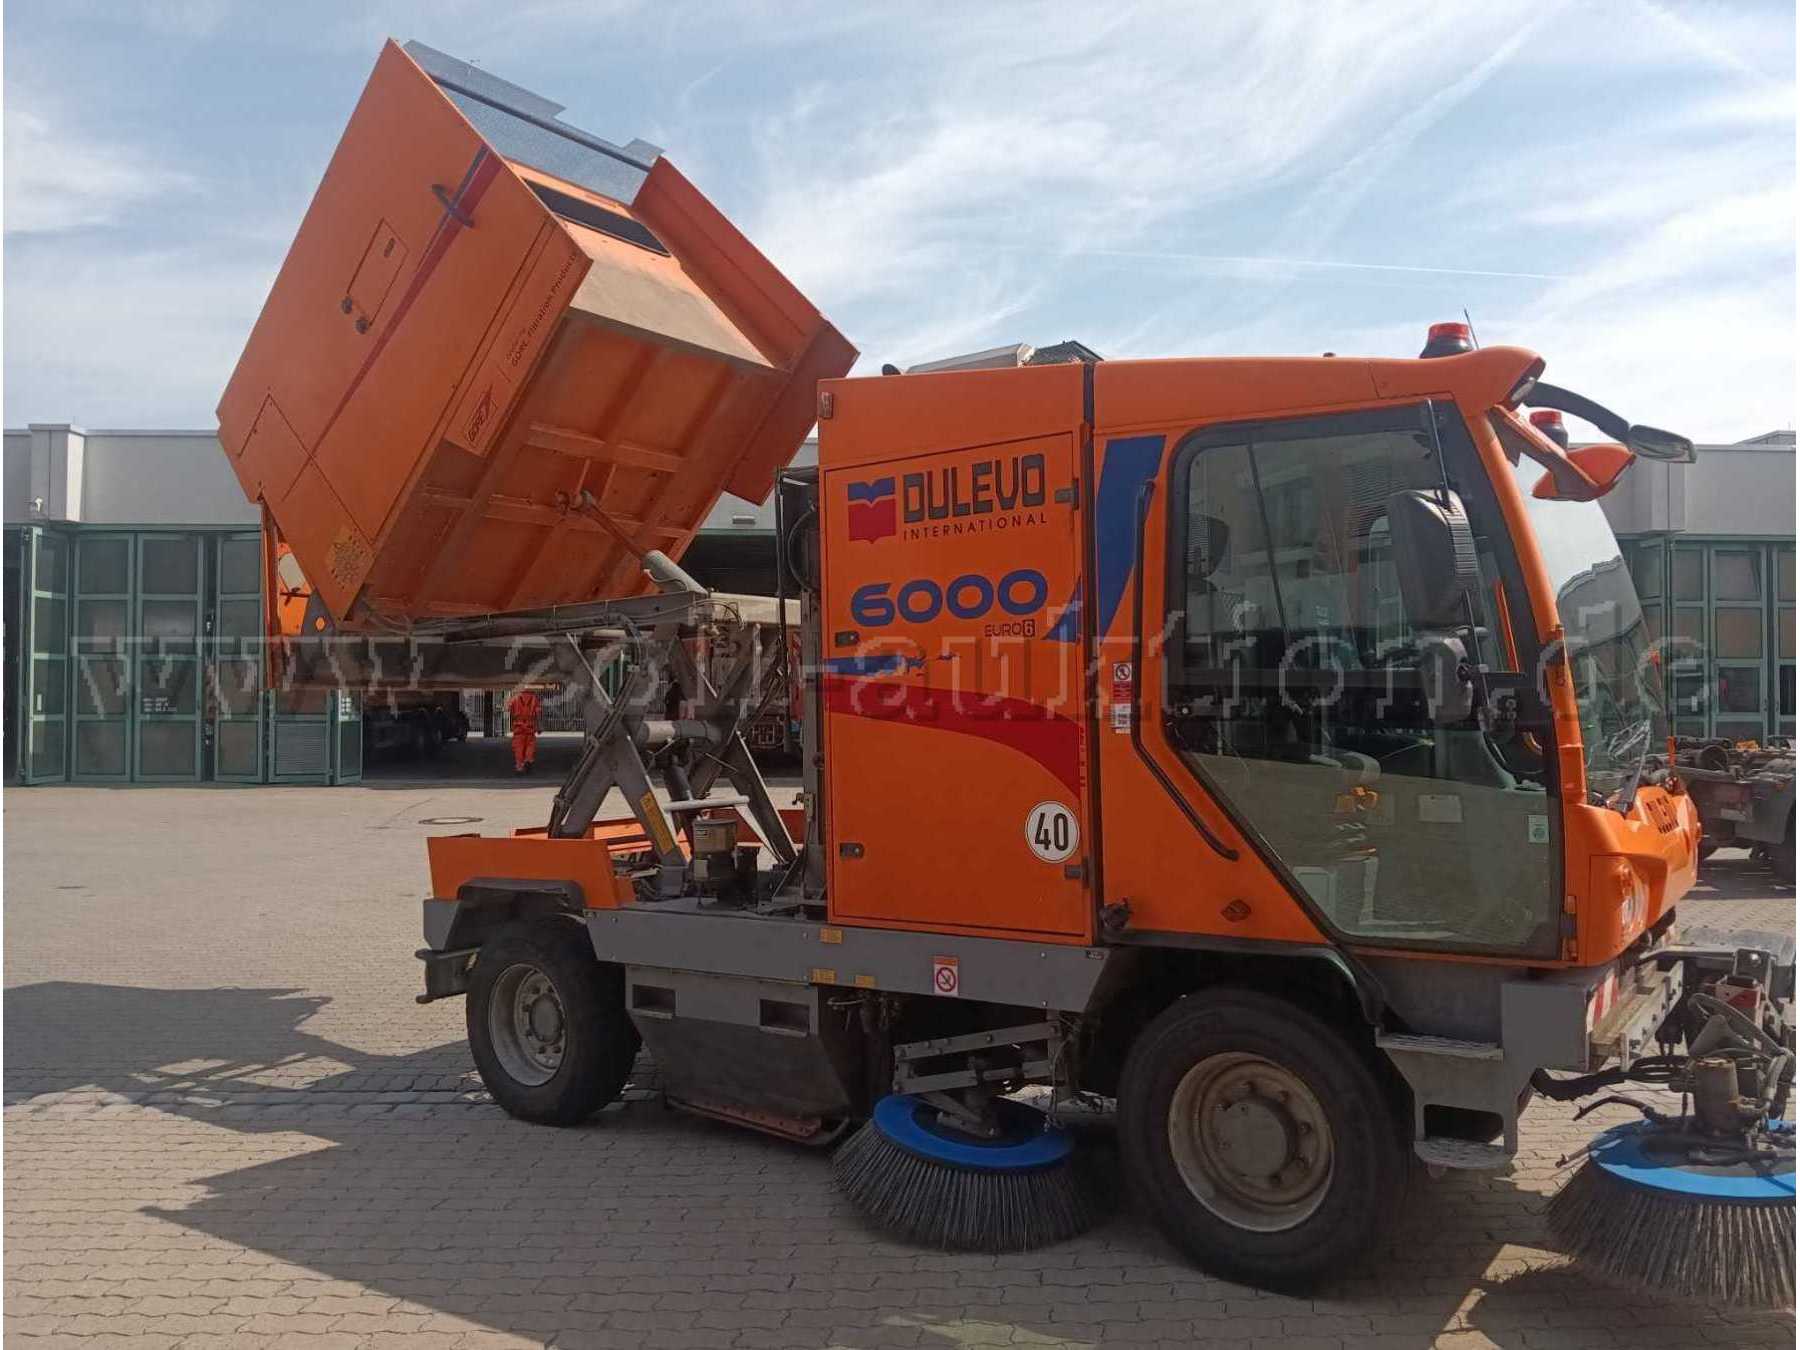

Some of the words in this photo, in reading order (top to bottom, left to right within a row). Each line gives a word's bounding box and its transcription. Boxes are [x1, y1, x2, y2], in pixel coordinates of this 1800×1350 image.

[903, 452, 1046, 524] DULEVO
[903, 512, 1048, 542] INTERNATIONAL
[850, 568, 1049, 627] 6000
[1034, 812, 1069, 852] 40
